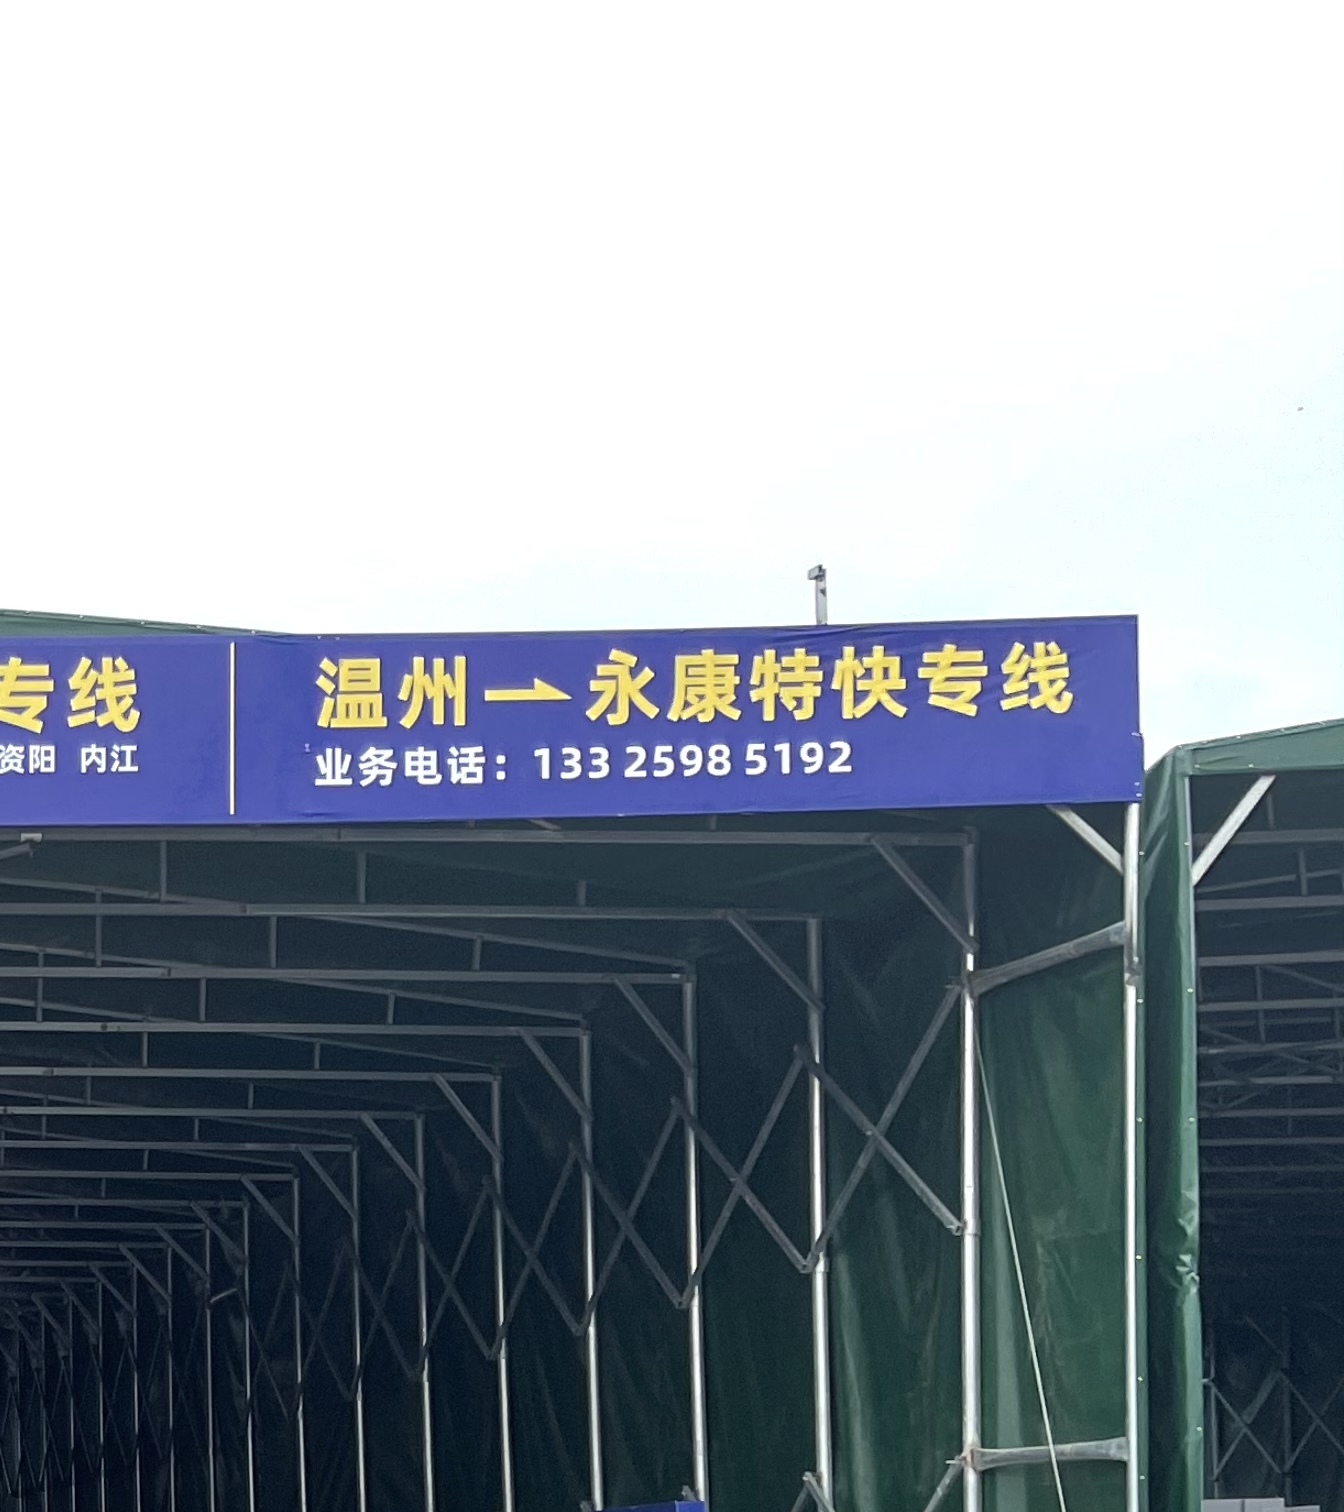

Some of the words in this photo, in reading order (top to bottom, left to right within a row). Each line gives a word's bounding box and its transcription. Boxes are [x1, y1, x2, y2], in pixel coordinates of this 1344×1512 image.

[316, 656, 466, 729] 温州
[586, 642, 1073, 725] 永康特快专线
[81, 744, 138, 773] 内江
[534, 747, 609, 779] 133
[624, 744, 731, 777] 2598
[746, 741, 851, 775] 5192
